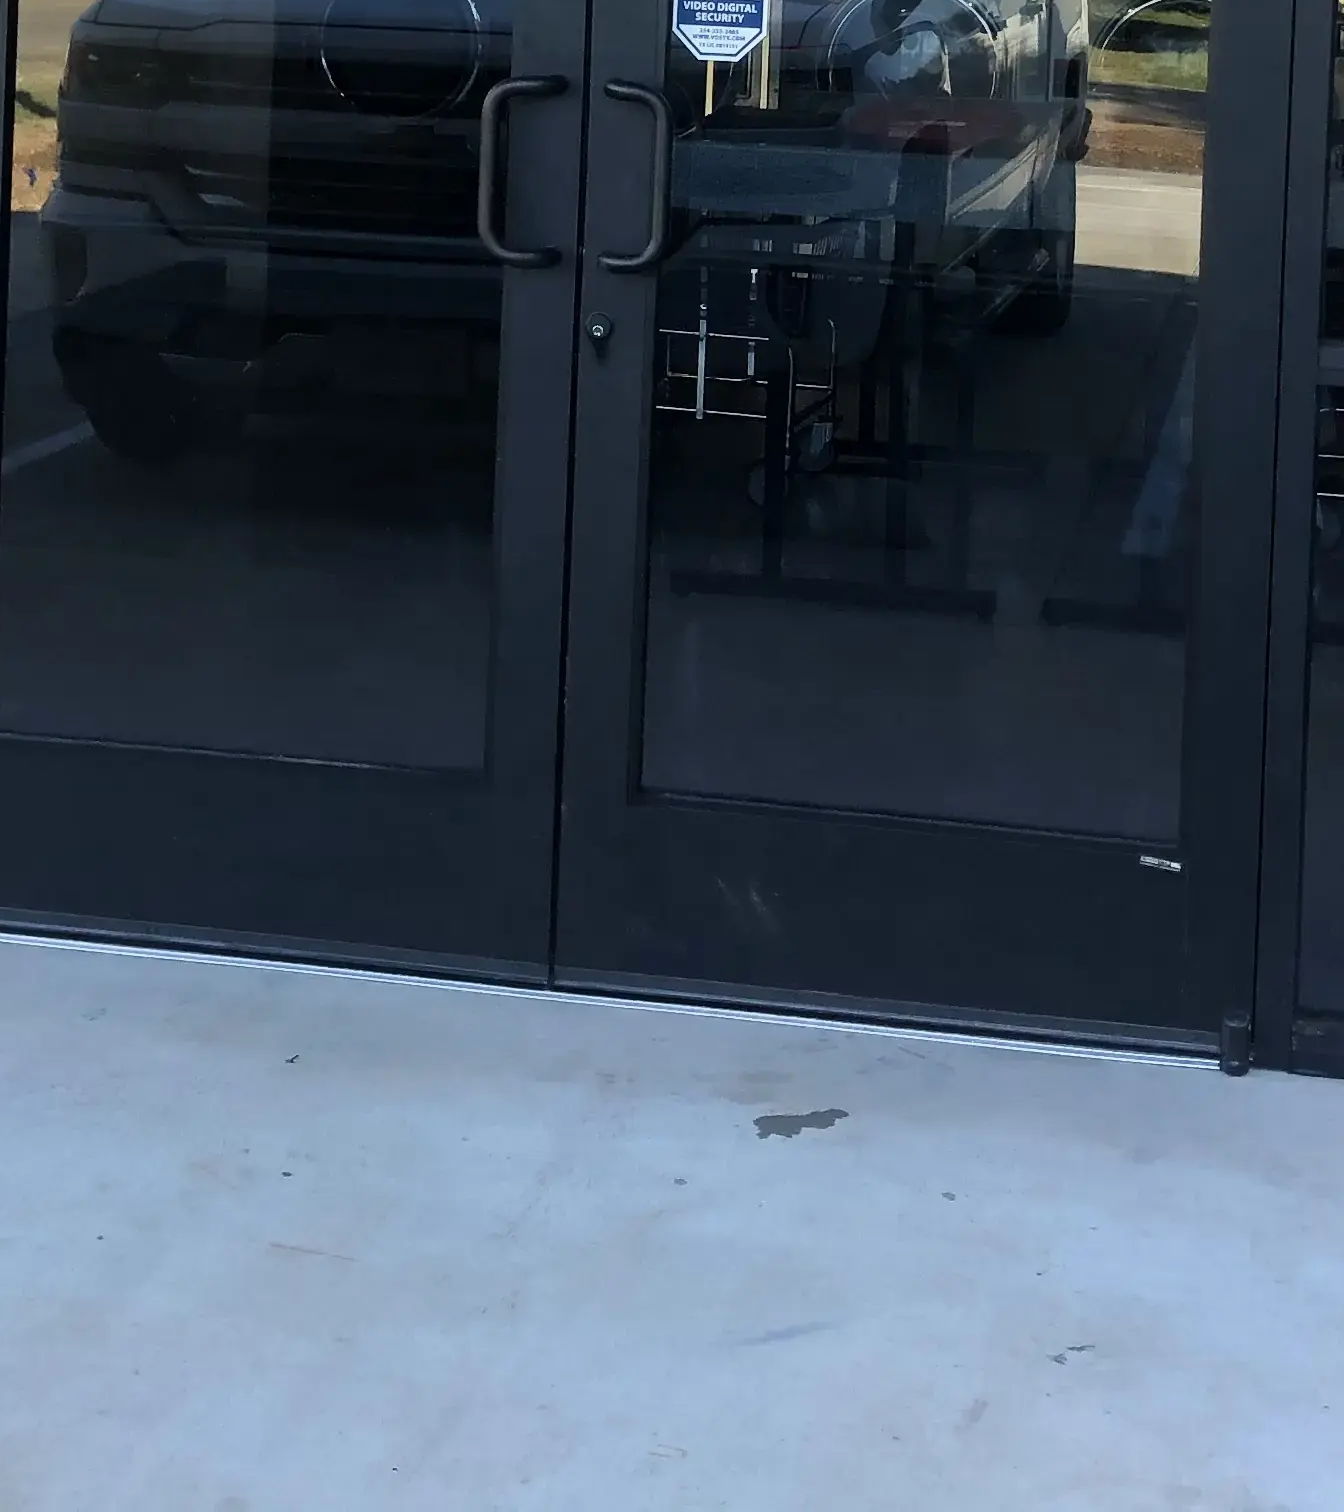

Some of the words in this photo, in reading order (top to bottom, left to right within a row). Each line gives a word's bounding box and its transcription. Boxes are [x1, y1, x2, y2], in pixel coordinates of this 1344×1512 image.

[683, 0, 716, 11] VIDEO
[716, 2, 758, 13] DIGITAL
[695, 12, 745, 23] SECURITY
